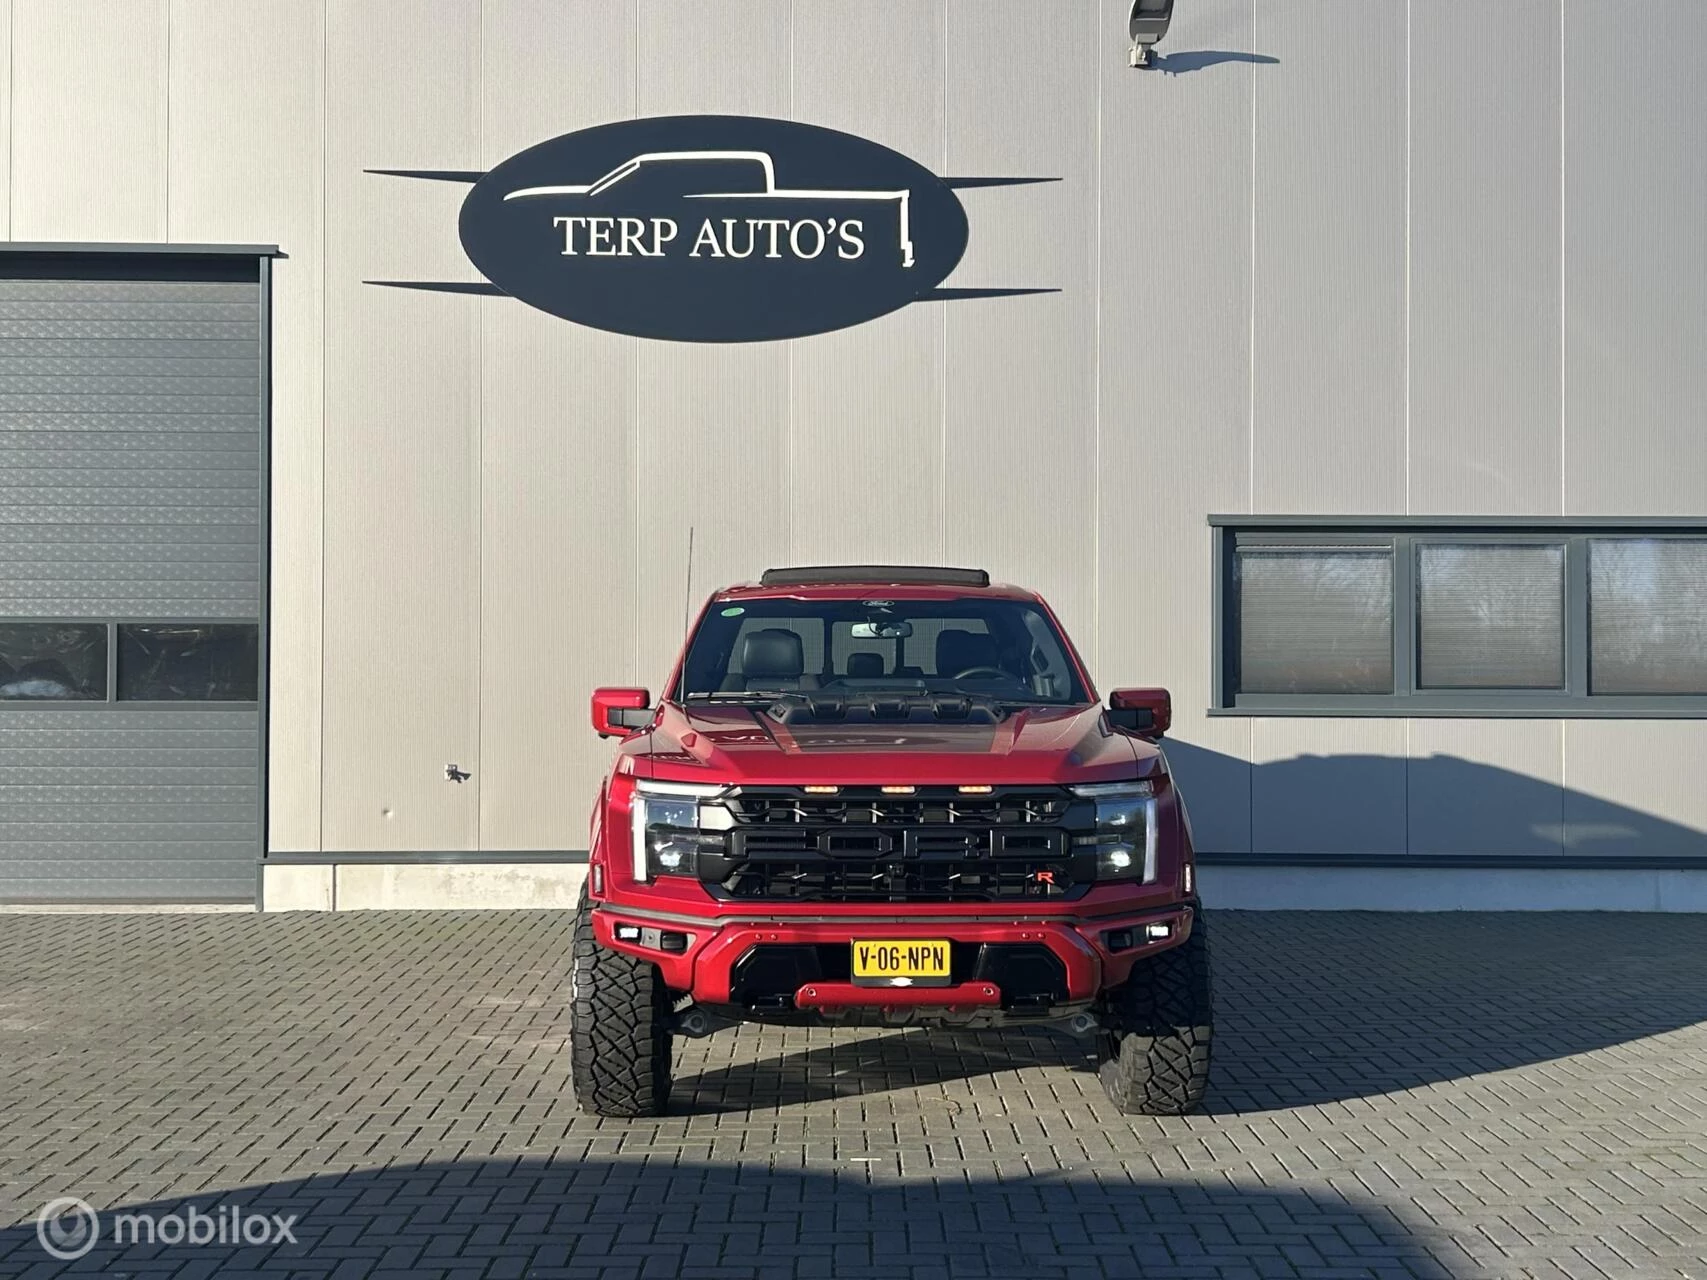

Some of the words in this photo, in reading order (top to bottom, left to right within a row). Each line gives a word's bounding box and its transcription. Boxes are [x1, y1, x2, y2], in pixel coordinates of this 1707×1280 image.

[553, 216, 679, 257] TERP
[688, 217, 866, 260] AUTO'S
[1037, 872, 1055, 884] R
[859, 946, 944, 971] V-06-NPN
